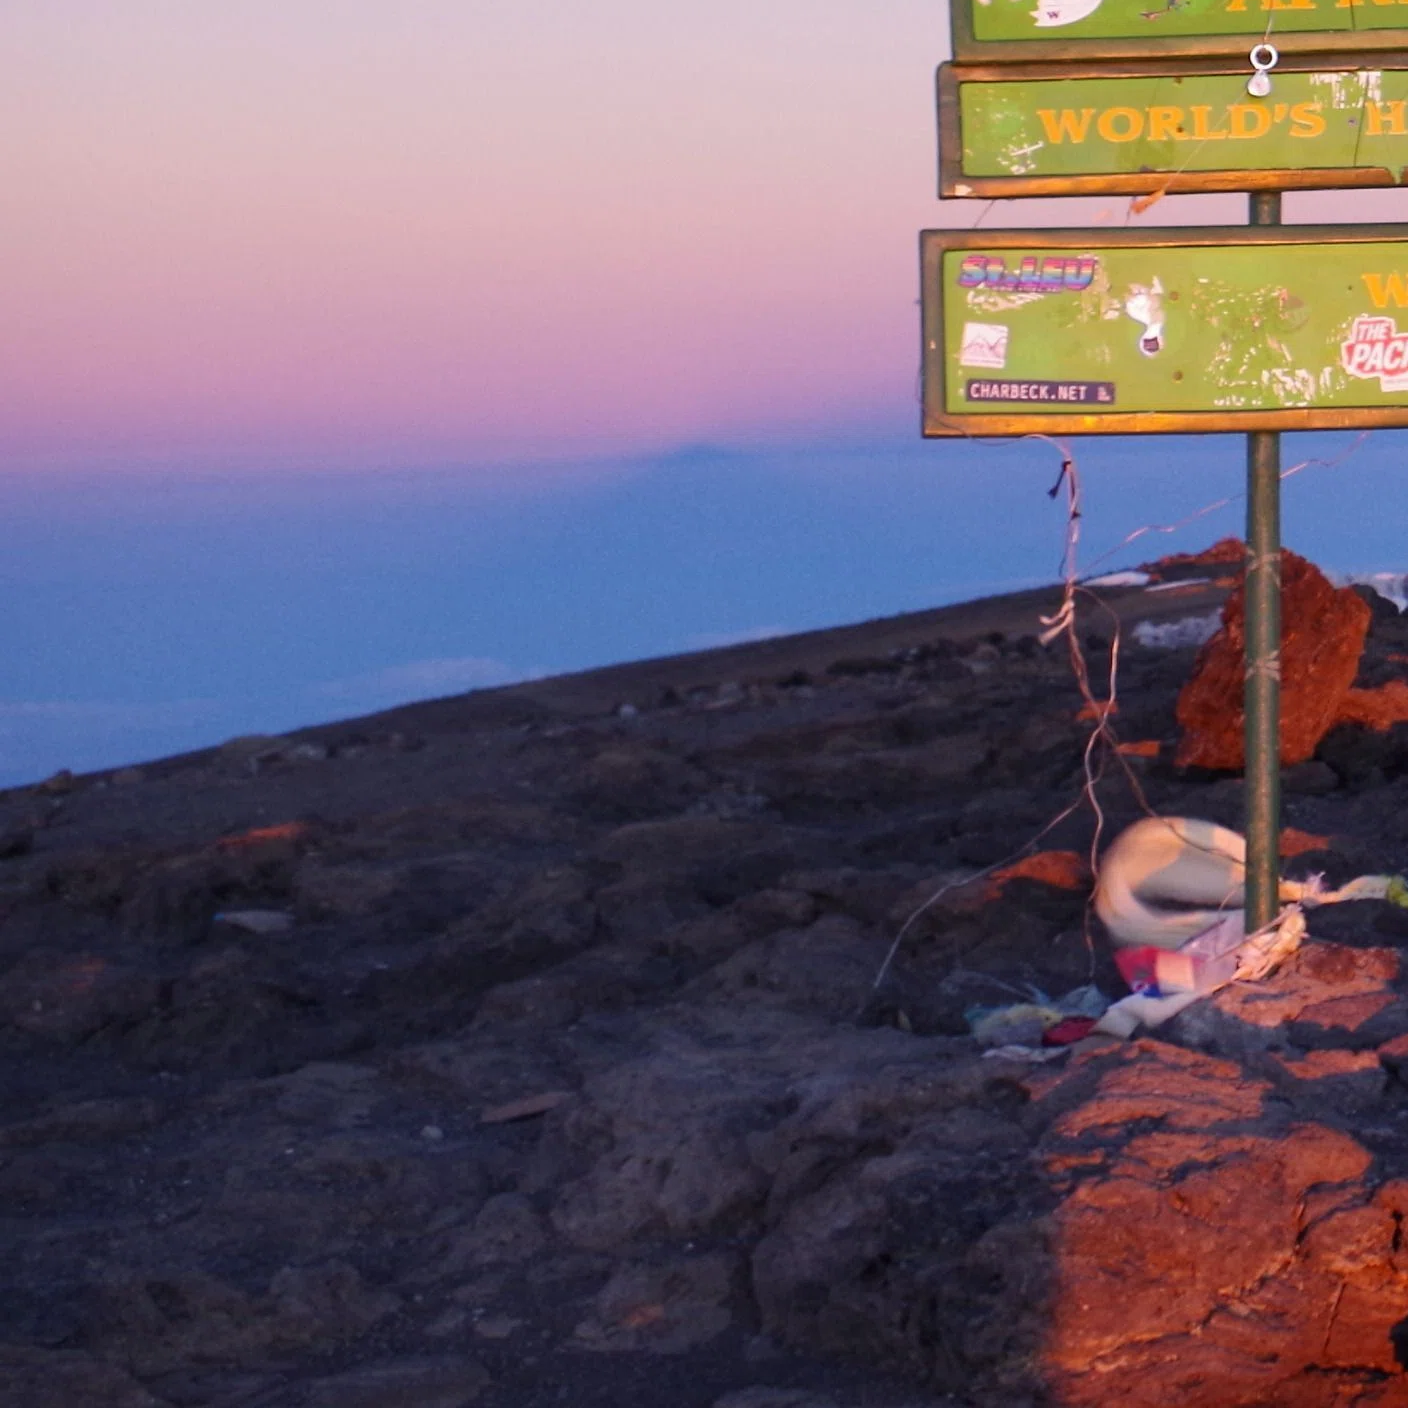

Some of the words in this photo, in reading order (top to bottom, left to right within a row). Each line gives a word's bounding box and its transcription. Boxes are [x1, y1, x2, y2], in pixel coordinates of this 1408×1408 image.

[1036, 100, 1327, 147] WORLD'S
[1358, 322, 1390, 341] THE
[970, 382, 1087, 401] CHARBECK.NET
